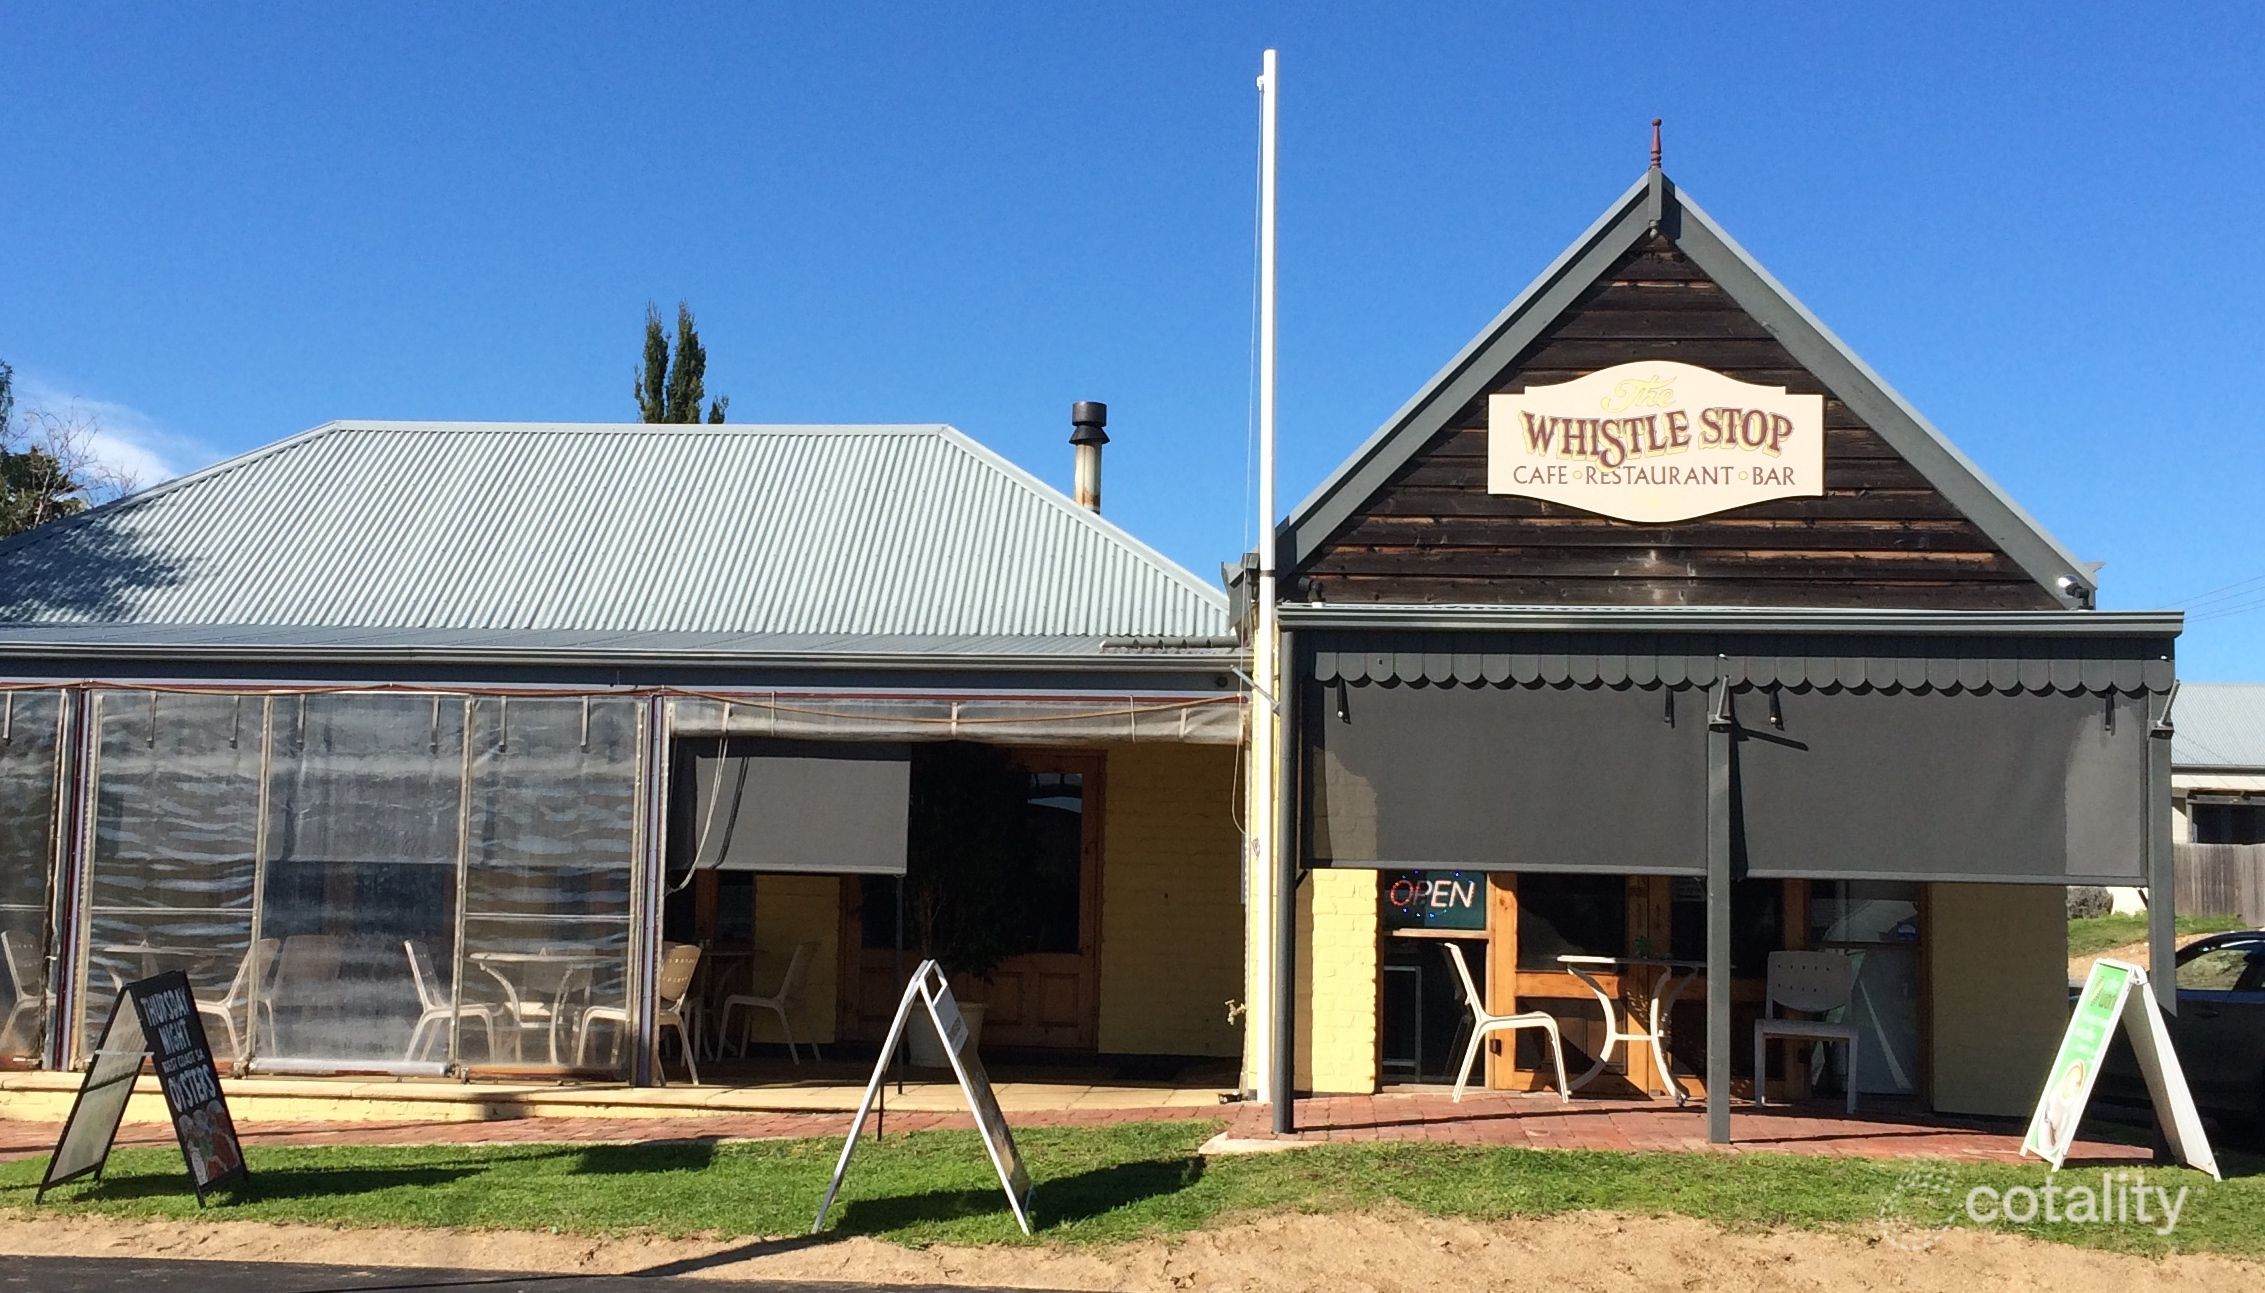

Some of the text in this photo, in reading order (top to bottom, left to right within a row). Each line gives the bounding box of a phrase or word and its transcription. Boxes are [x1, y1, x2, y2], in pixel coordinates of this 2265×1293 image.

[1520, 407, 1794, 471] WHISTLE STOP
[1513, 465, 1796, 486] CAFE RESTAURANT BAR
[1390, 879, 1476, 908] OPEN
[140, 985, 189, 1027] THURSDAY
[159, 1018, 191, 1055] NIGHT
[168, 1064, 216, 1112] OYSTERS
